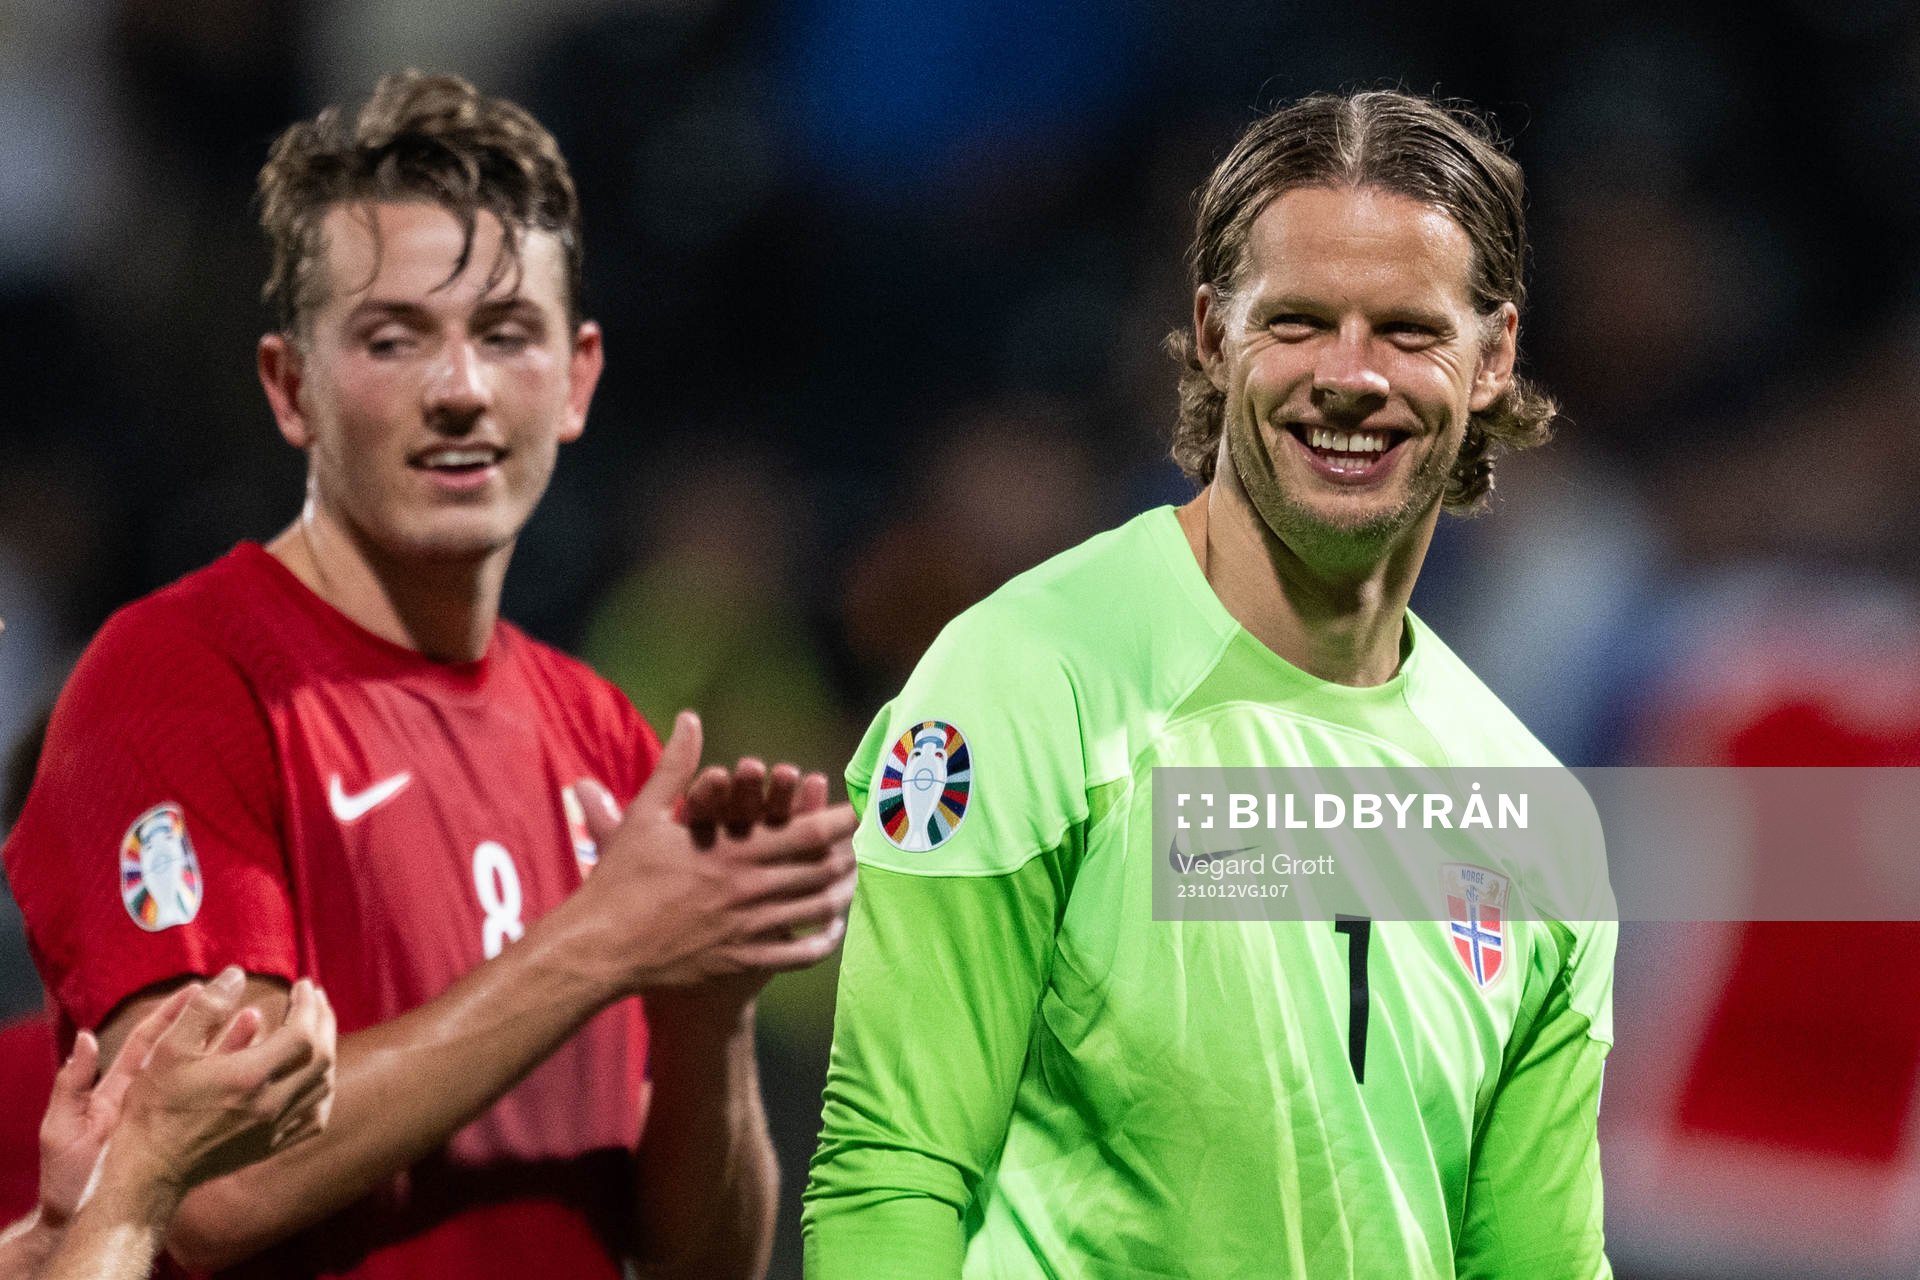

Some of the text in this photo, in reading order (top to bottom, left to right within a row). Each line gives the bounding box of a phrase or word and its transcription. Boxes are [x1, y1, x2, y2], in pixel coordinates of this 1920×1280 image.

[473, 840, 525, 960] 8
[1461, 868, 1485, 885] NORGE
[1334, 913, 1372, 1085] 1
